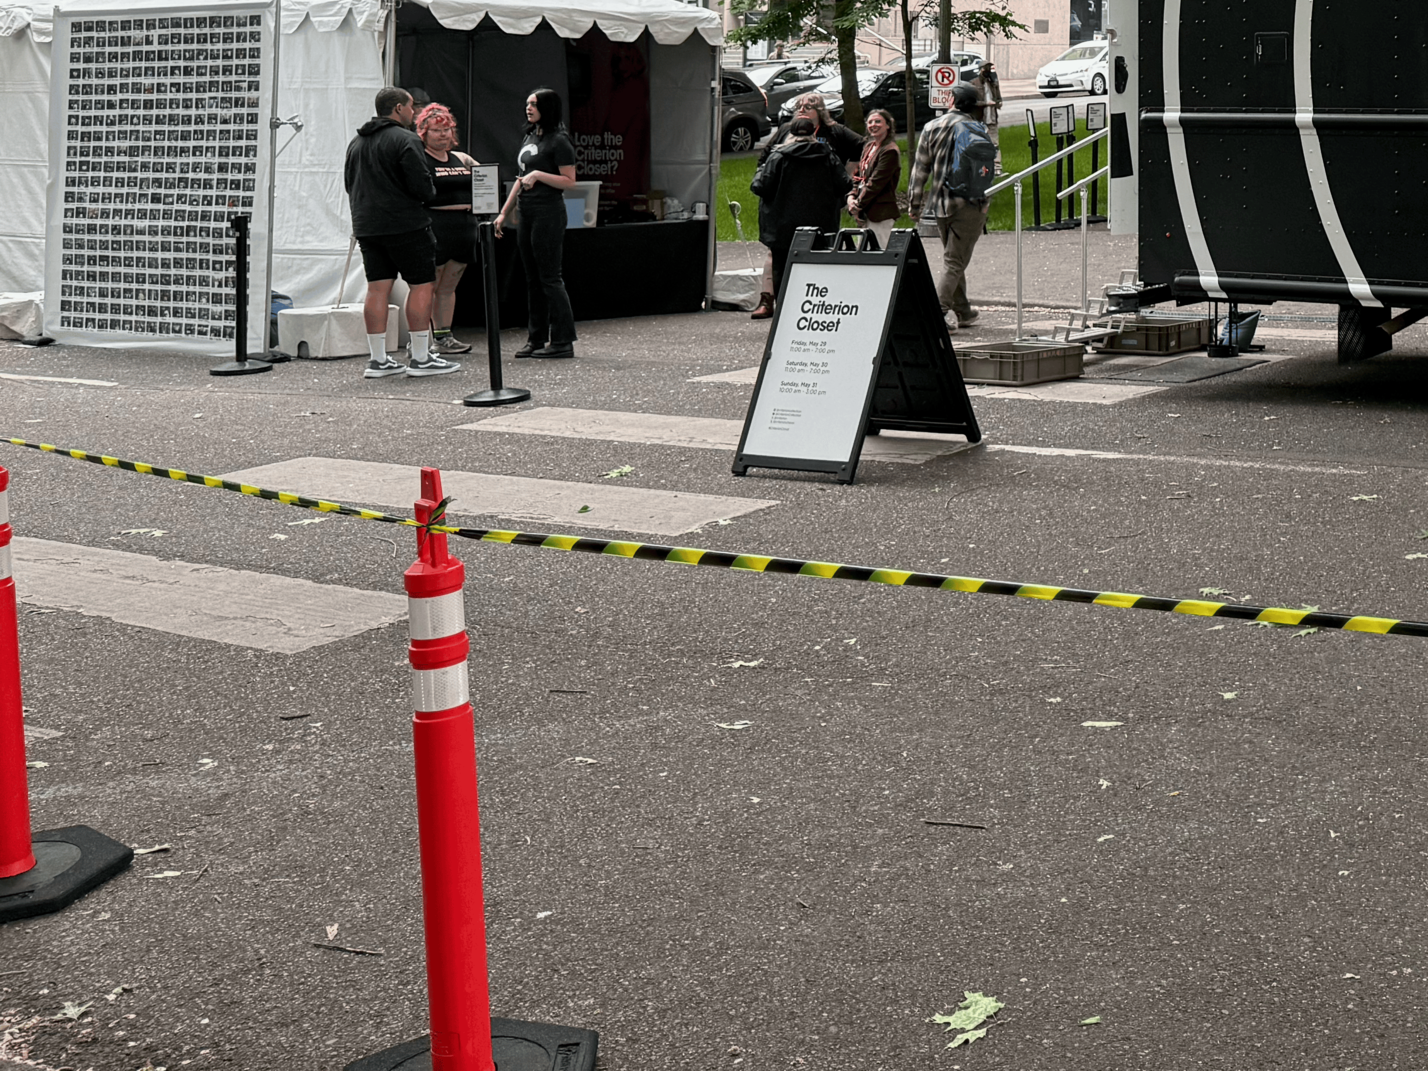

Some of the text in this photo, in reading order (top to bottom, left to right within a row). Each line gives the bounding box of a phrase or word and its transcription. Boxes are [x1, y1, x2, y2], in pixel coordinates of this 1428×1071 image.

[932, 96, 949, 104] BLO
[574, 131, 623, 146] Love the
[575, 146, 624, 161] Criterion
[575, 160, 619, 175] Closet?
[805, 283, 829, 298] The
[801, 299, 859, 316] Criterion
[796, 316, 841, 332] Closet
[786, 360, 809, 368] Saturday,
